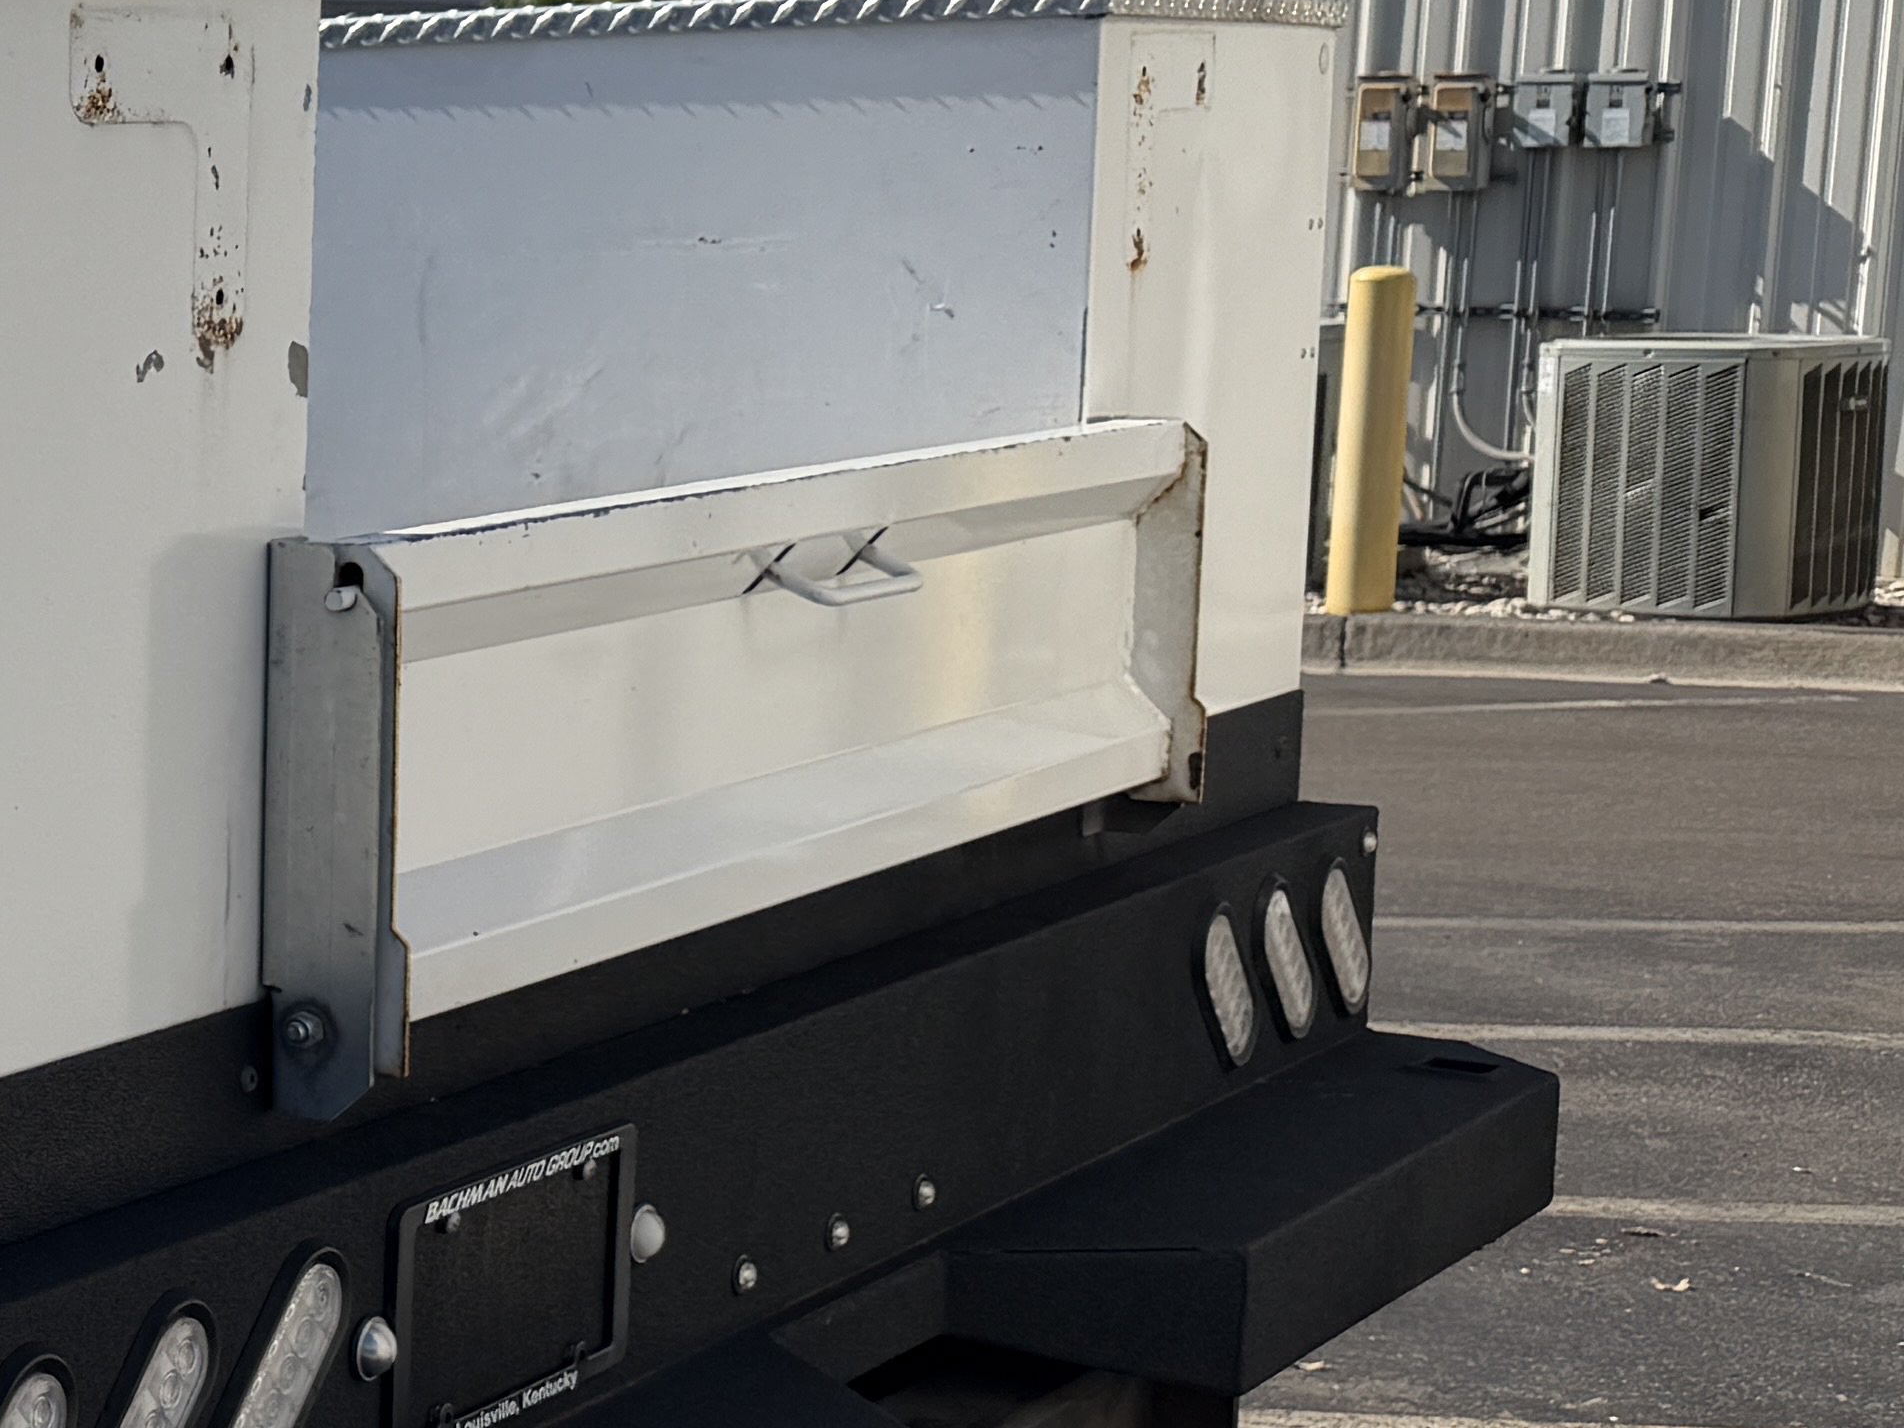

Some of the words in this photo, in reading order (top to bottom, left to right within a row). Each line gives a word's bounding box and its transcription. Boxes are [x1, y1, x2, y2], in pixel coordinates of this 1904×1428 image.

[425, 1175, 509, 1224] BACHMAN
[506, 1159, 544, 1194] AUTO
[522, 1368, 579, 1409] Kentucky
